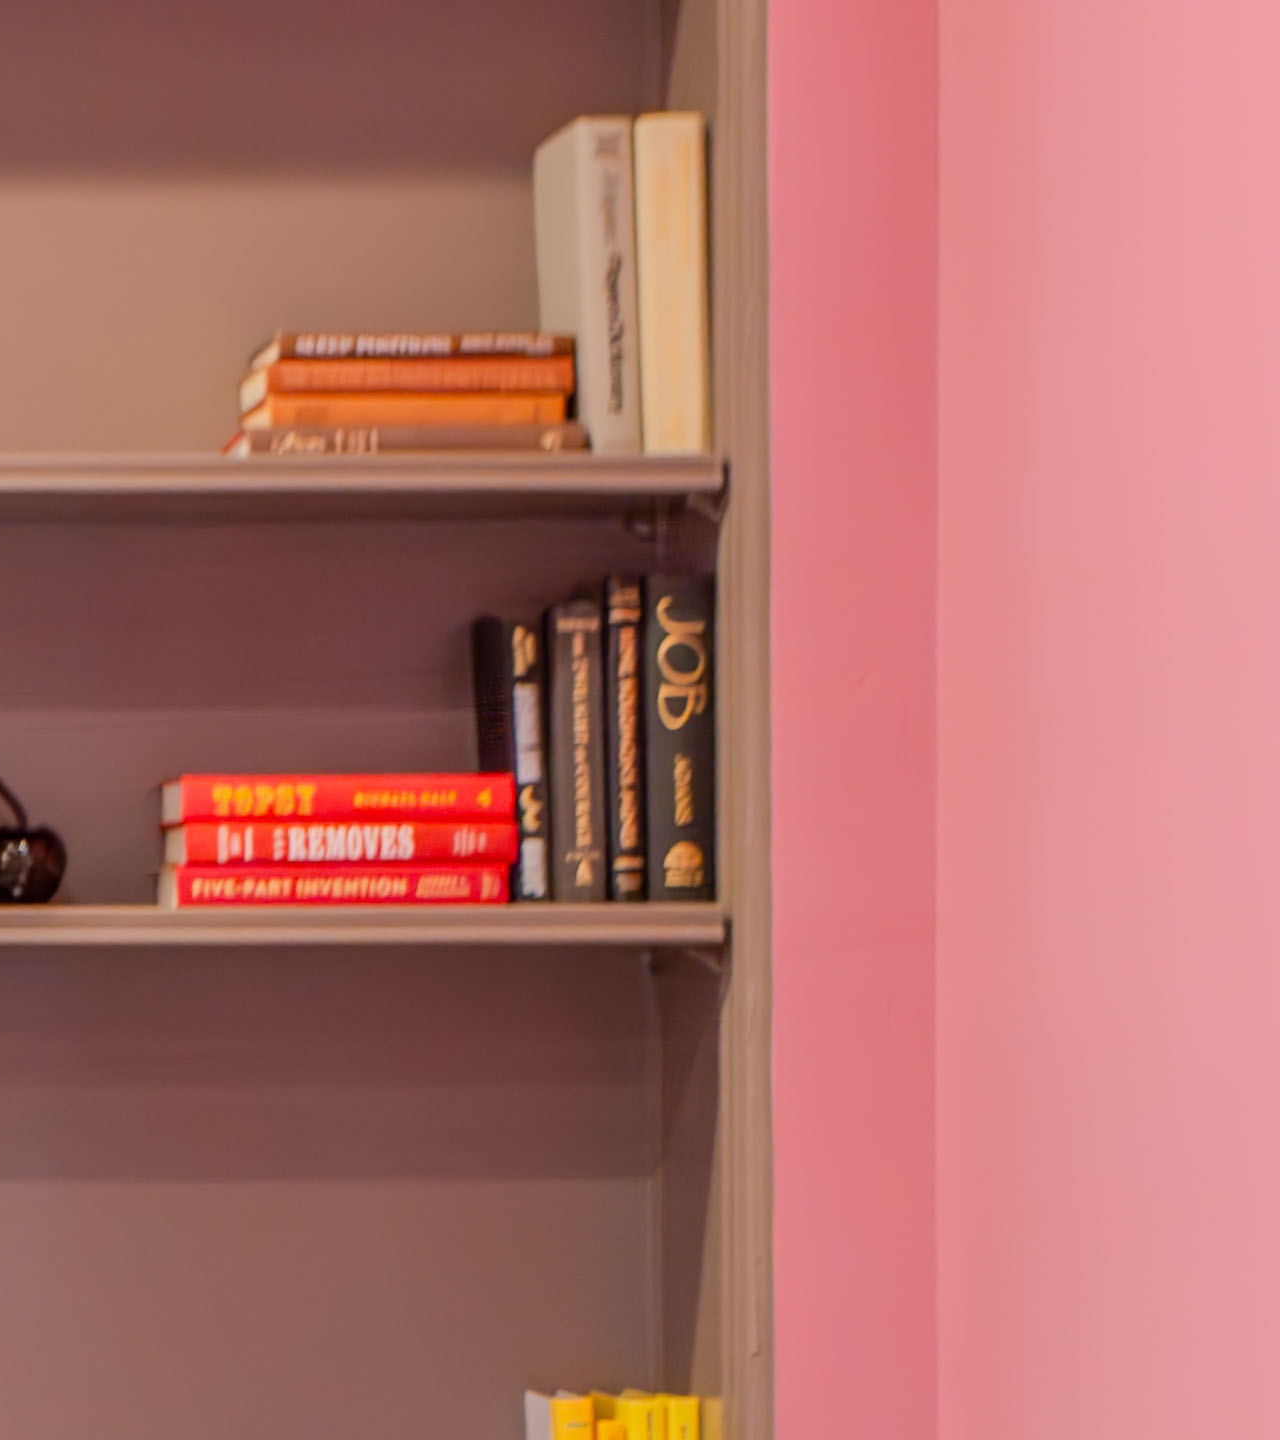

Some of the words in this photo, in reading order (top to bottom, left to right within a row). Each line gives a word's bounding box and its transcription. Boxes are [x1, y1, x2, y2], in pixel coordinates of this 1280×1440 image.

[656, 595, 707, 731] JOB
[212, 784, 317, 816] TOPSY
[288, 824, 415, 862] REMOVES
[191, 877, 293, 899] FIVE-PART
[296, 876, 409, 899] INVENTION
